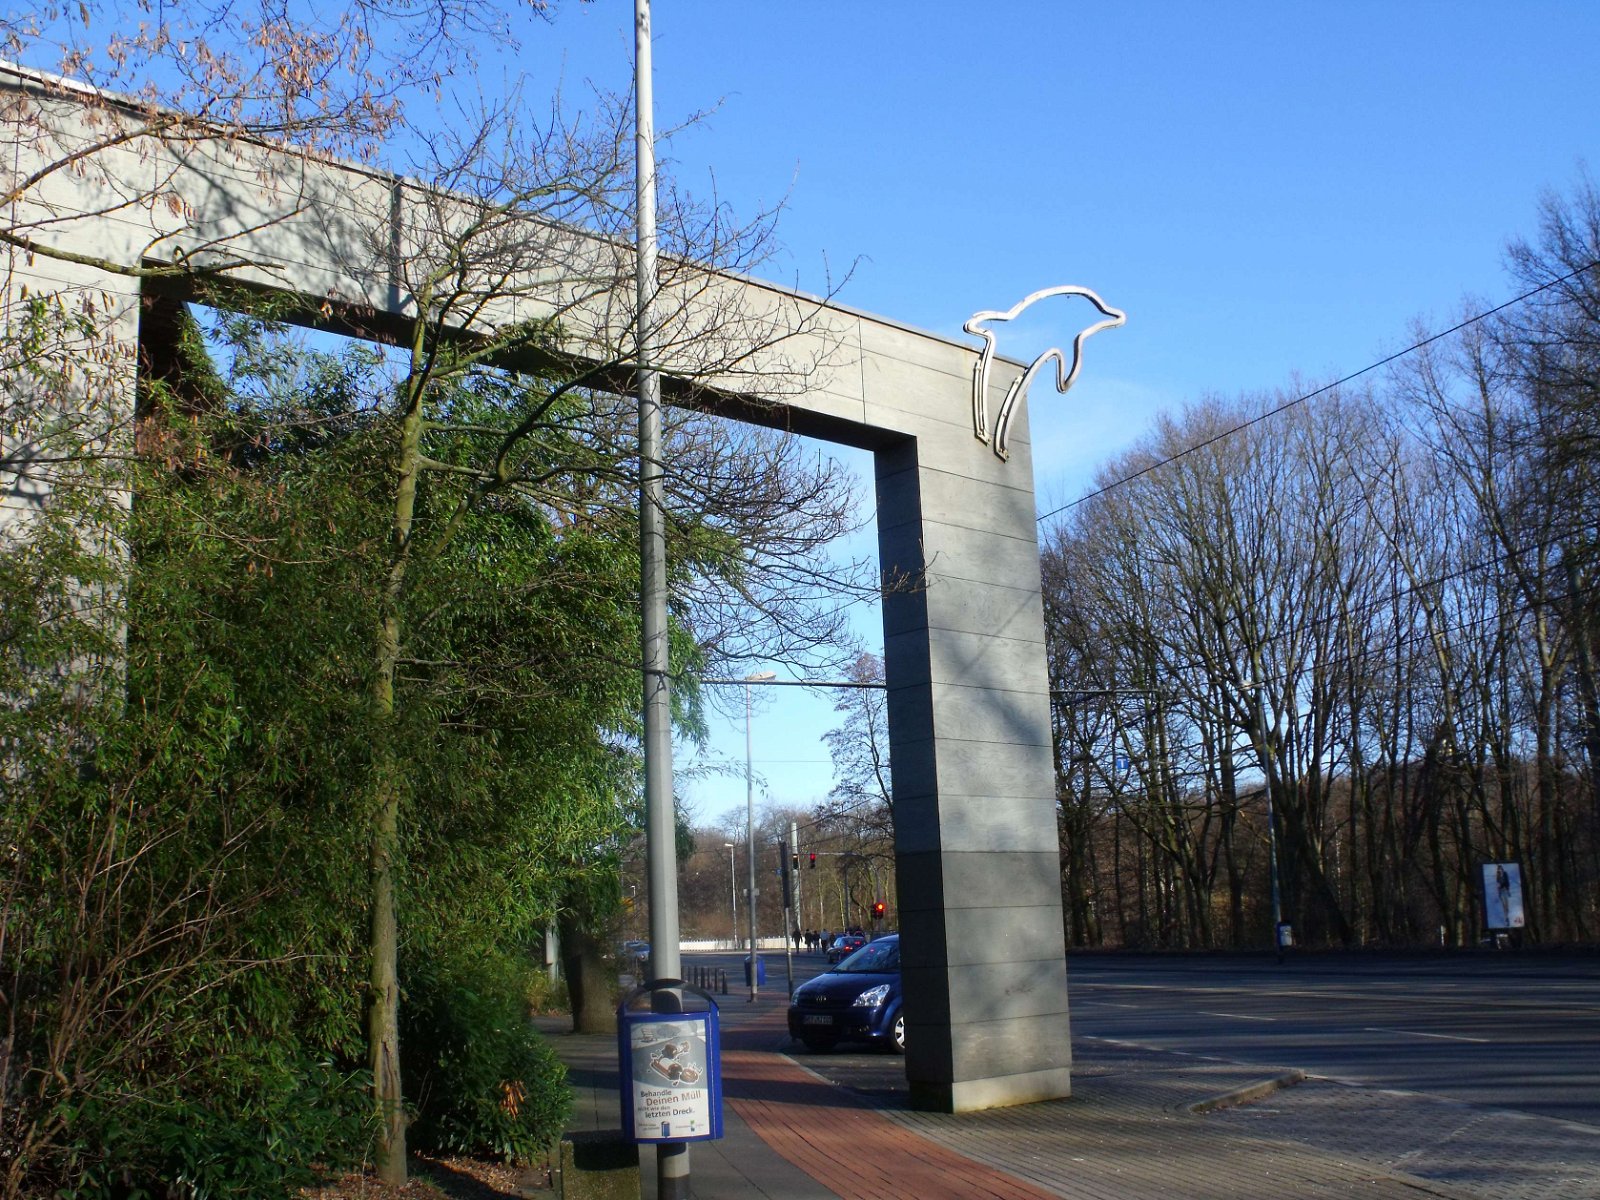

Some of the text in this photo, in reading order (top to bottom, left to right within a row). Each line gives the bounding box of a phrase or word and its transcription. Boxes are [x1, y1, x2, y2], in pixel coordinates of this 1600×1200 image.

[640, 1089, 672, 1098] Behandle
[646, 1090, 701, 1106] Deinen Müll
[645, 1110, 671, 1119] letzten
